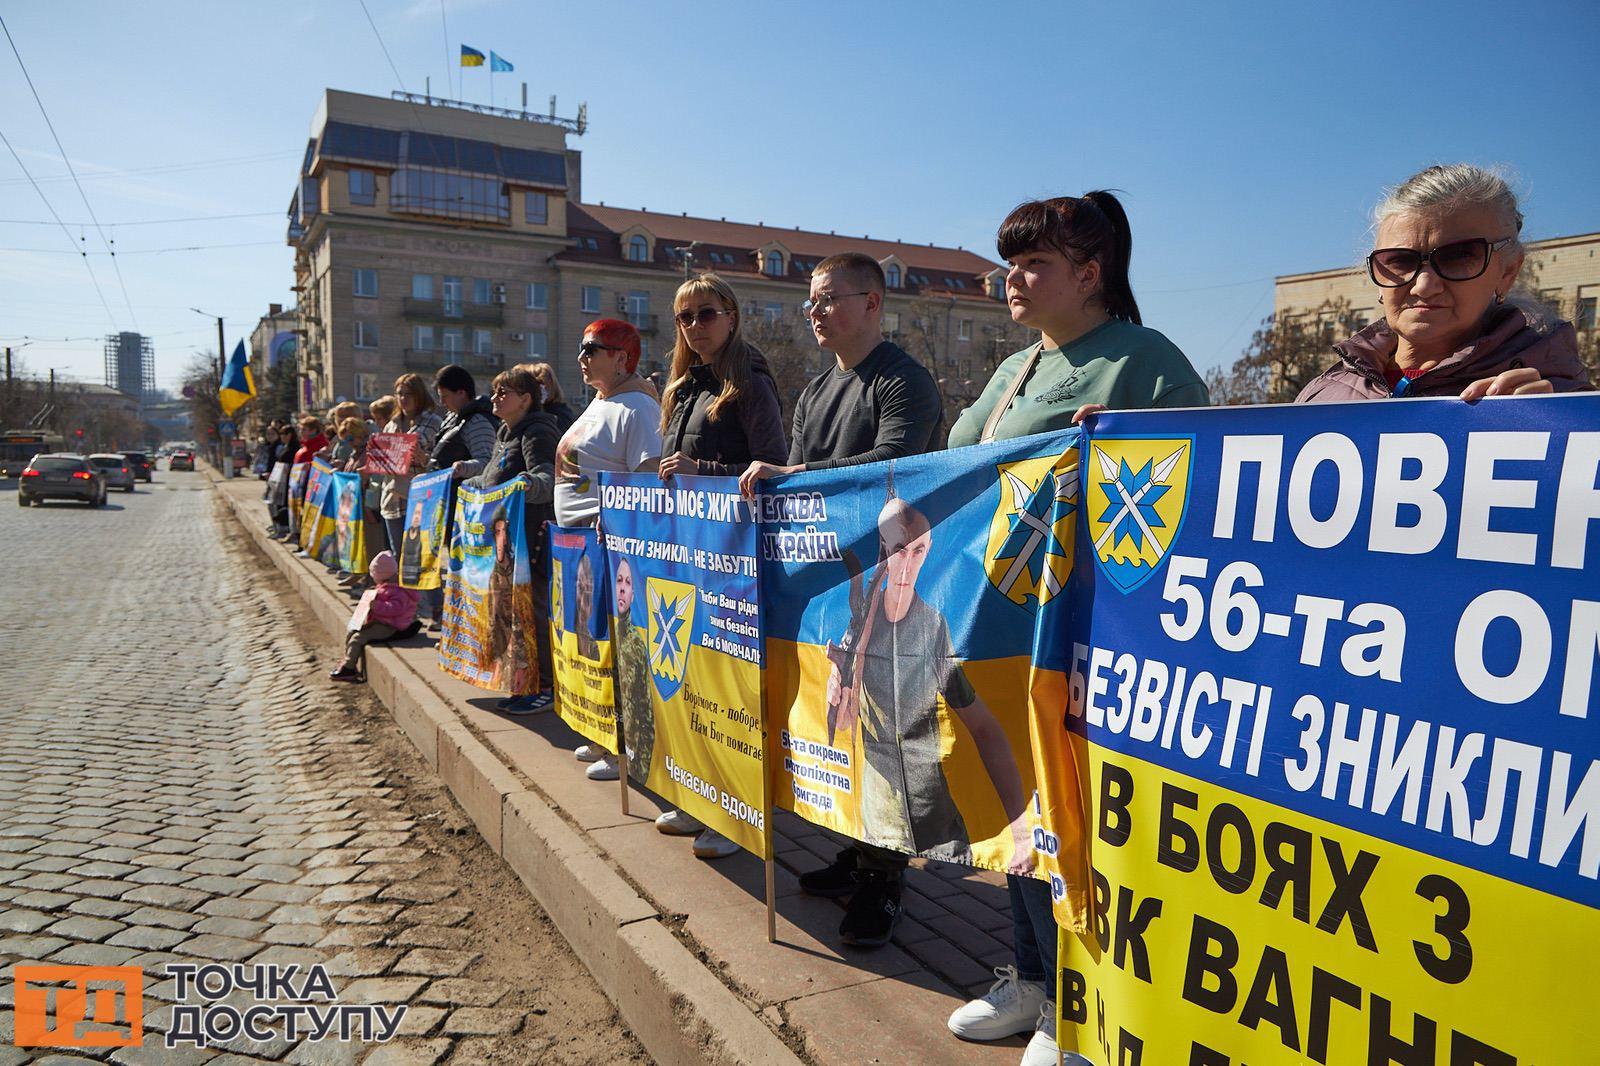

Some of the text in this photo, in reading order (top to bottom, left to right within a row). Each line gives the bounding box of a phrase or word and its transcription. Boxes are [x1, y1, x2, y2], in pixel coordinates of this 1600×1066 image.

[676, 489, 705, 519] МОЄ
[763, 525, 843, 562] УКРАЇНІ
[694, 549, 706, 570] НЕ
[708, 552, 758, 578] ЗАБУТІ!
[719, 593, 737, 611] Ваш
[1159, 555, 1406, 683] 56-та
[701, 633, 714, 648] Ви
[683, 682, 718, 714] Борімося
[690, 712, 708, 737] Нам
[709, 720, 725, 744] Бог
[808, 743, 849, 766] окрема
[1068, 642, 1600, 880] БЕЗВІСТІ ЗНИКЛИ
[665, 755, 718, 804] Чекаємо
[1098, 761, 1473, 984] В БОЯХ З
